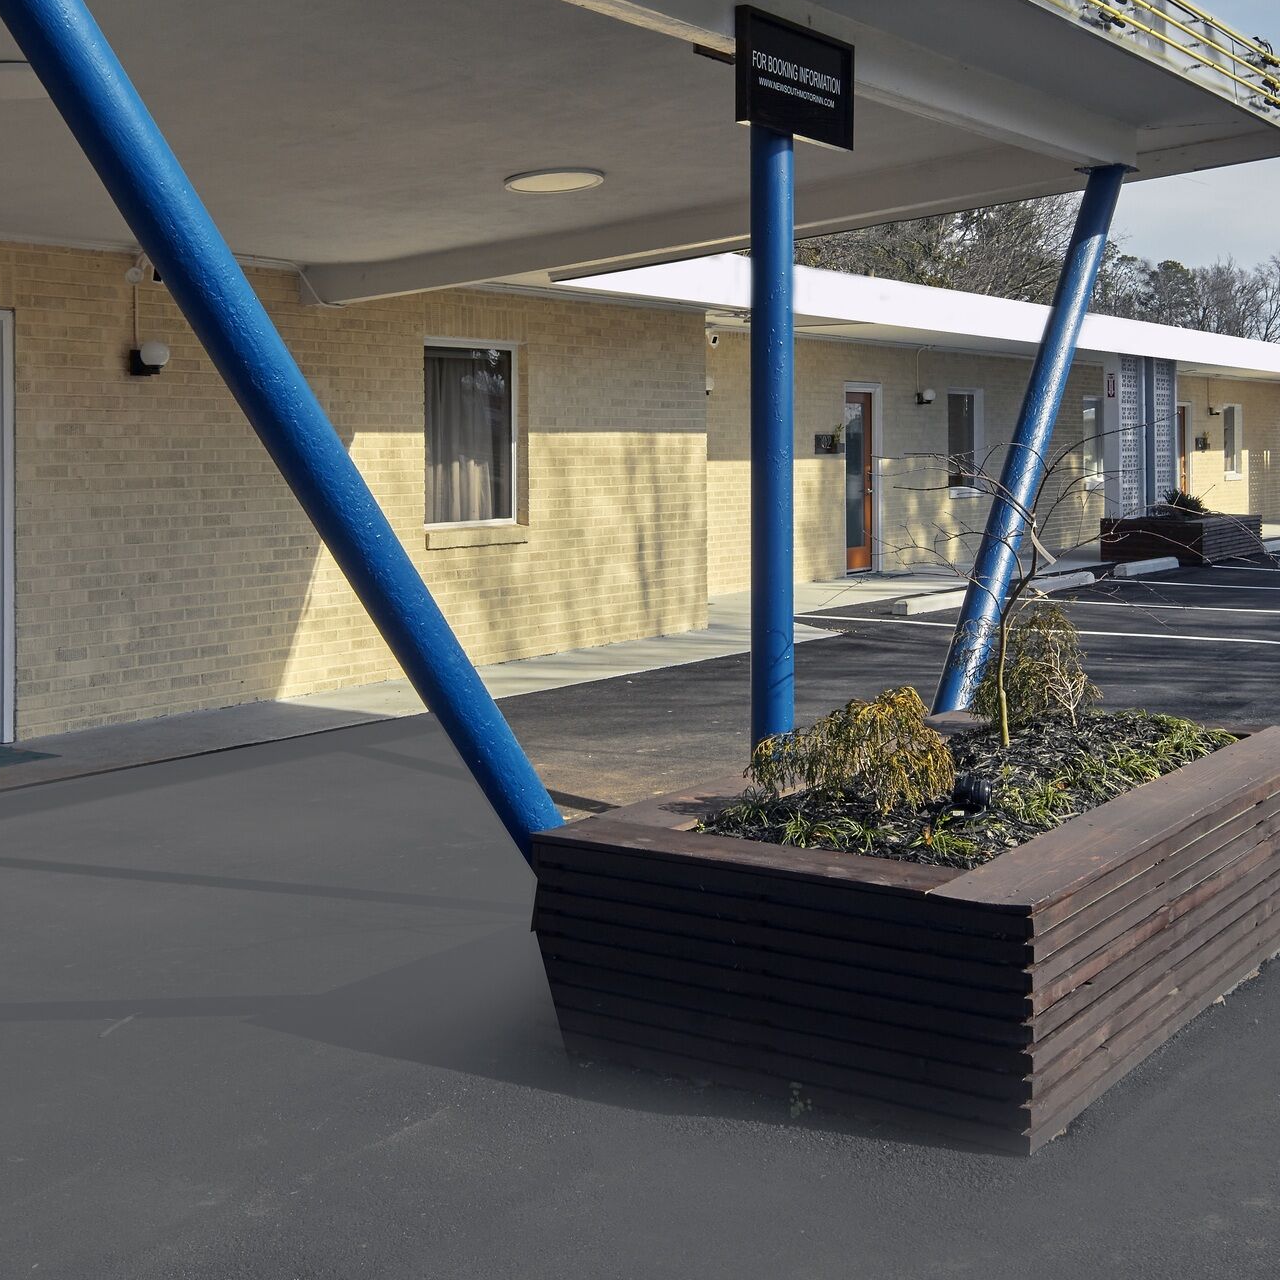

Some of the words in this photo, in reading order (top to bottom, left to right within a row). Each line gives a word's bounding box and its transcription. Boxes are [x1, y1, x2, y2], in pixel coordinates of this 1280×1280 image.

[752, 49, 767, 70] FOR
[768, 55, 798, 81] BOOKING
[799, 66, 840, 95] INFORMATION
[758, 76, 835, 109] WWW.NEWSOUTHMOTORINN.COM
